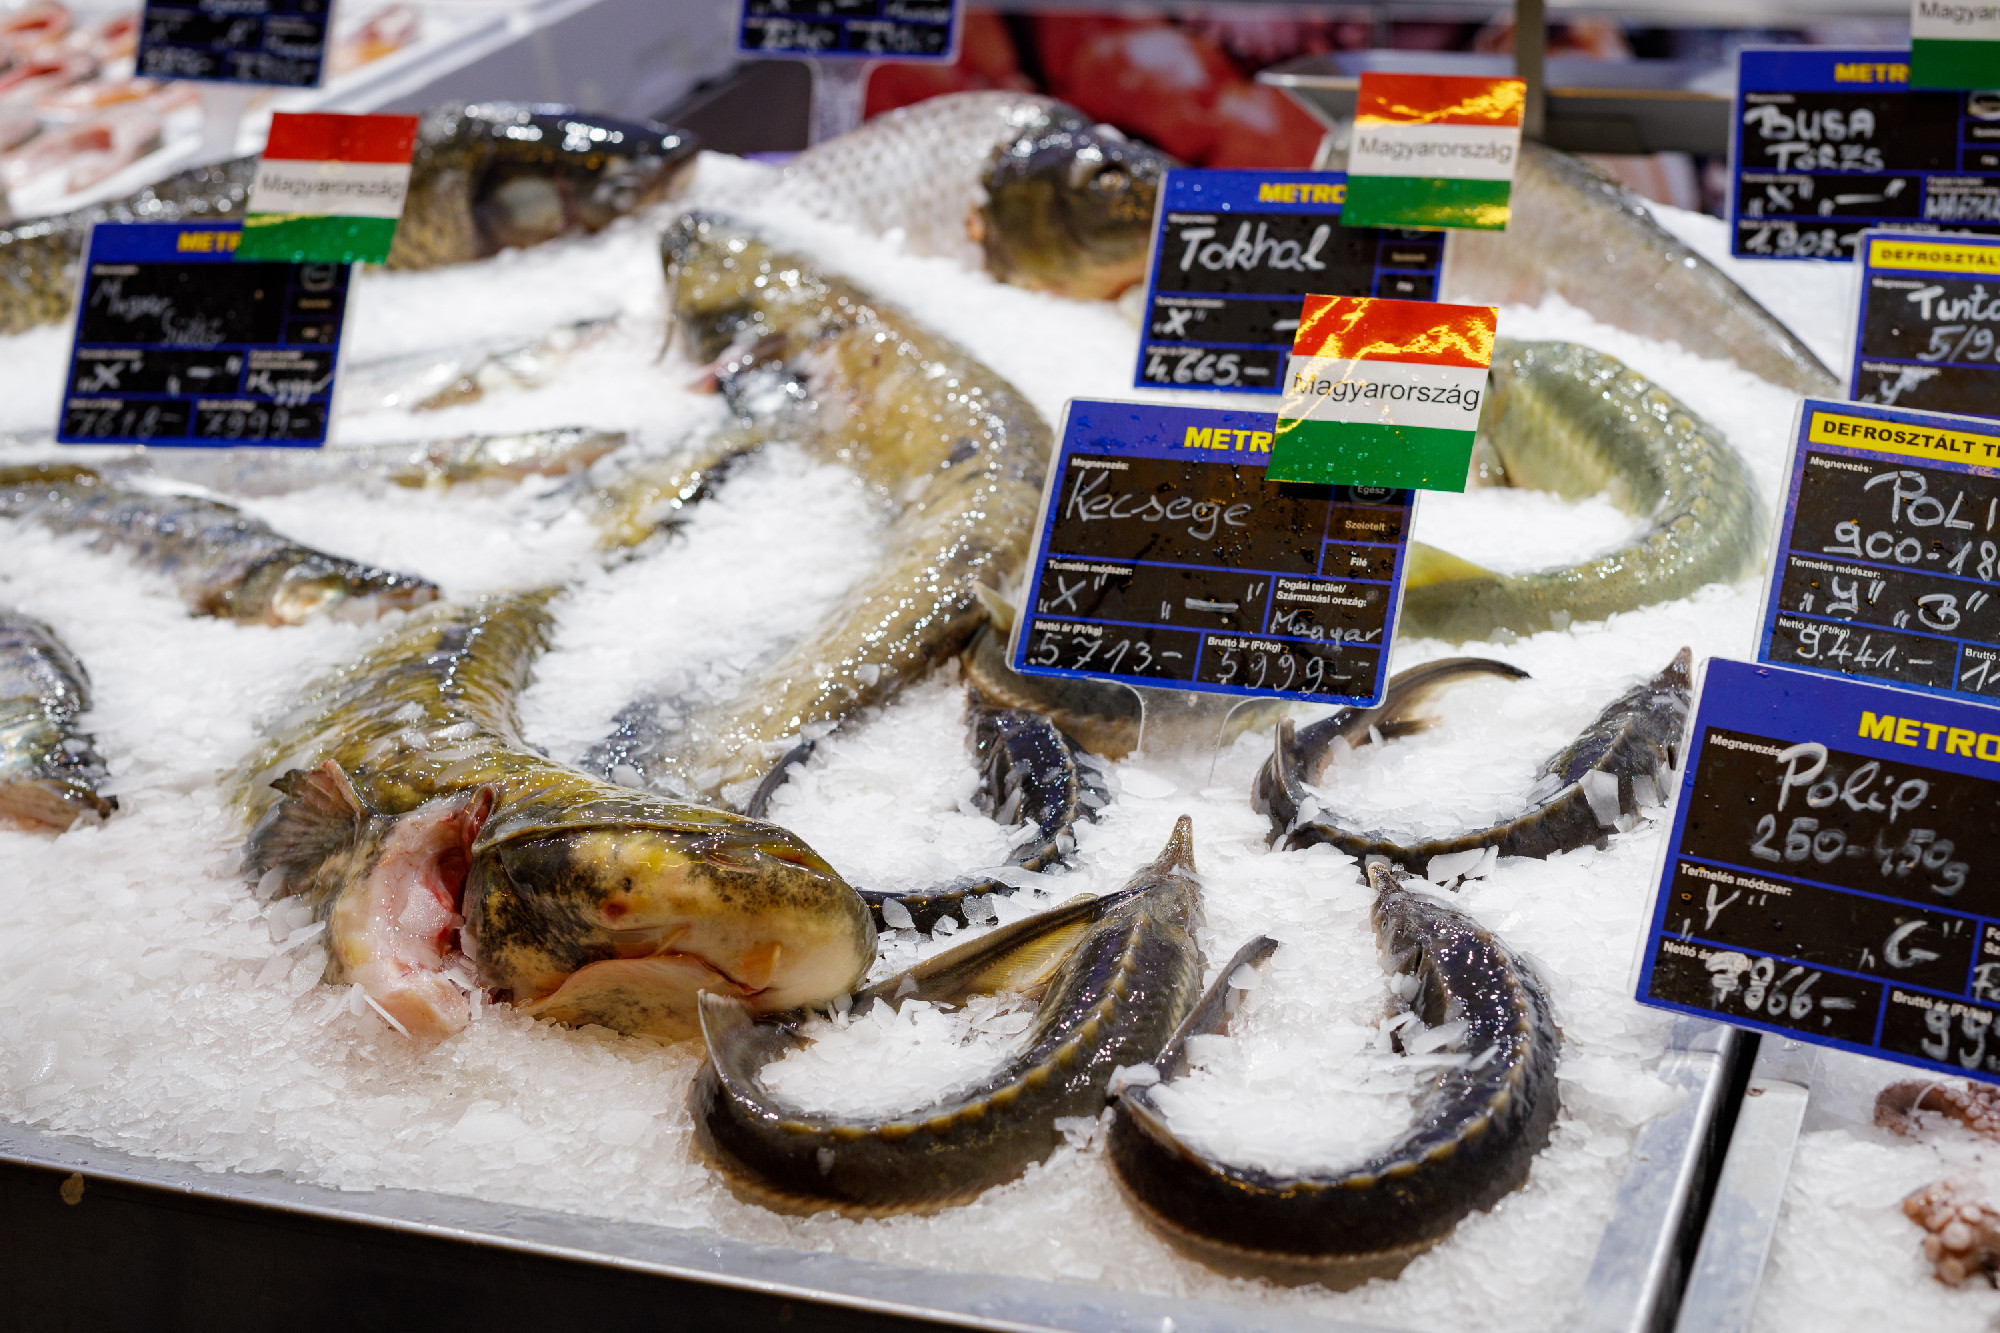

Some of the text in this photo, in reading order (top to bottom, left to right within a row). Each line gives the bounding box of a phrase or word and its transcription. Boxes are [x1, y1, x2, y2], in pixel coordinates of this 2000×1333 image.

[1834, 63, 1911, 83] METR
[1357, 136, 1513, 163] Magyarország
[262, 173, 400, 199] Magyarország
[1180, 220, 1331, 272] Tokhal
[1294, 372, 1480, 411] Magyarország
[1184, 426, 1275, 453] METR
[1823, 420, 1976, 454] DEFROSZTÁLT
[1810, 456, 1873, 474] Megnevezés:
[1066, 470, 1251, 540] Kecsege
[1790, 556, 1881, 580] Termelés módszer:
[1779, 618, 1804, 630] Nettó
[1965, 647, 1996, 661] Bruttó
[1858, 711, 2000, 763] METRO
[1777, 742, 1929, 824] Polip
[1681, 863, 1793, 896] Termelés módszer:
[1663, 940, 1697, 957] Nettó
